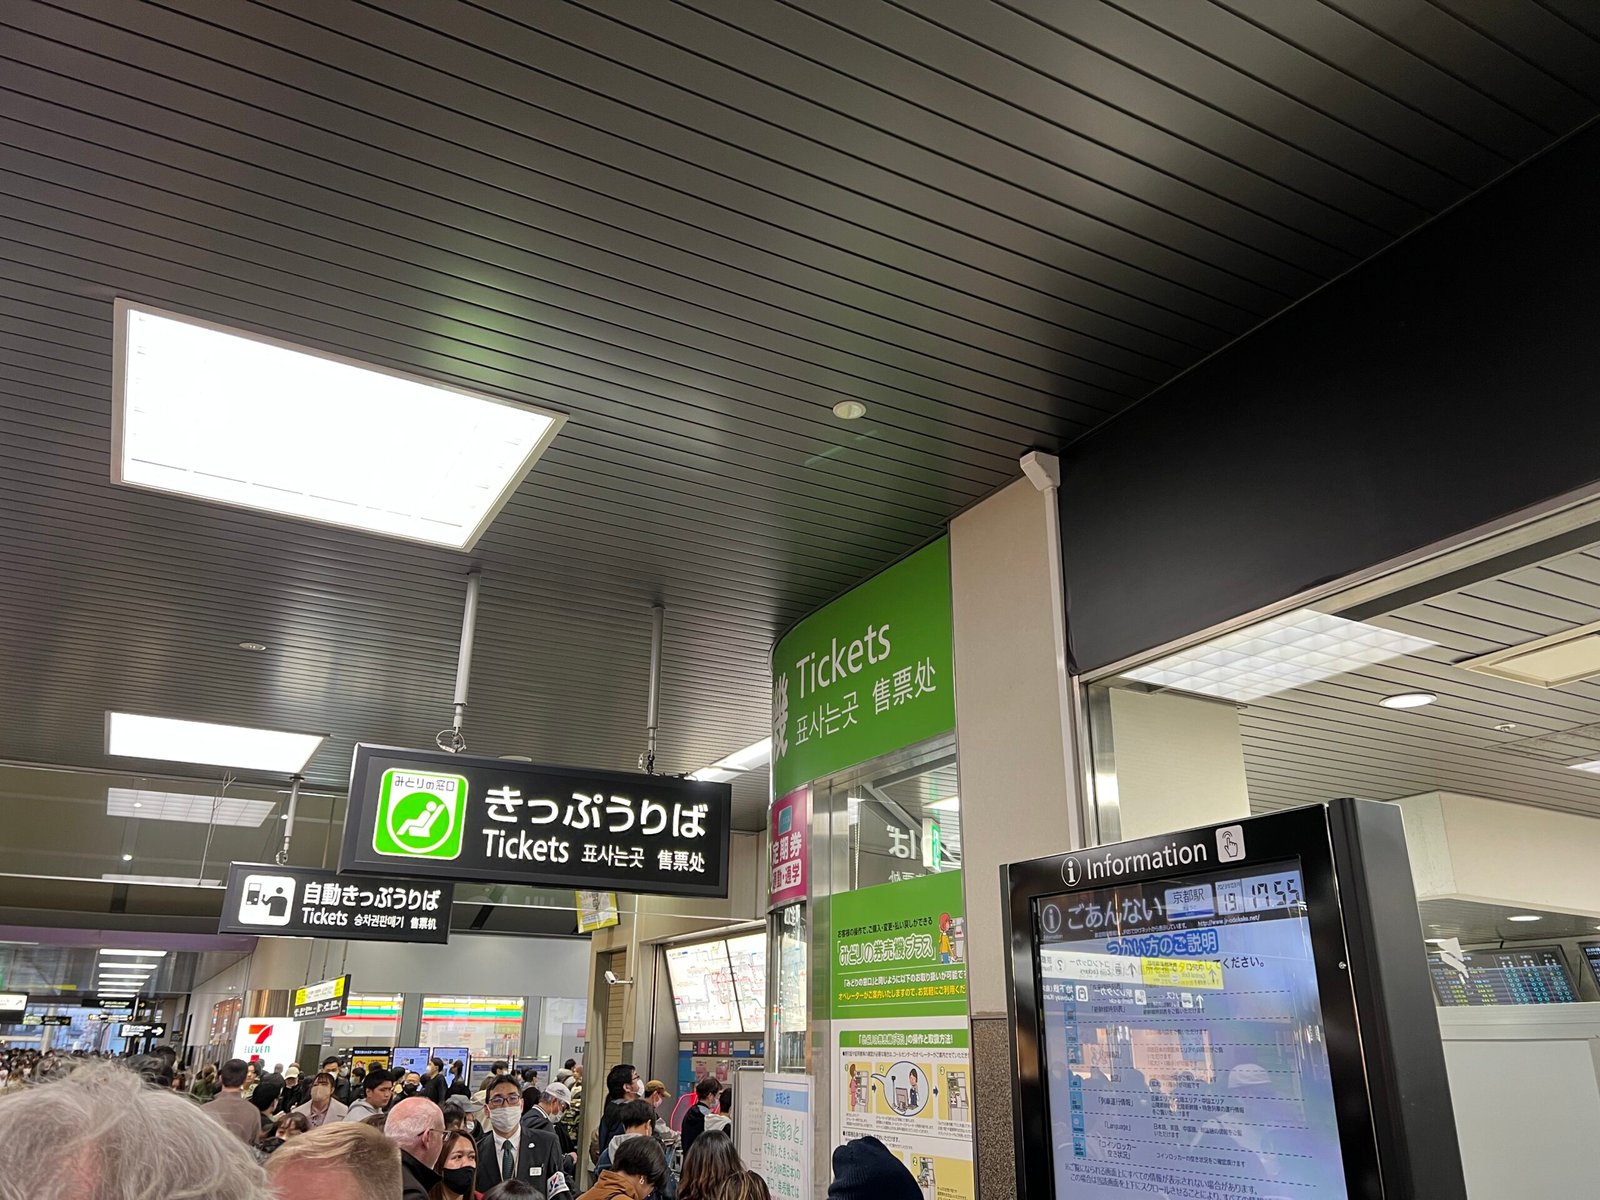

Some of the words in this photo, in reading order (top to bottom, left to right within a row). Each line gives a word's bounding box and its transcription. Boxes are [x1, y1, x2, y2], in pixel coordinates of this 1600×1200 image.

[796, 624, 891, 699] Tickets
[796, 691, 859, 746] 표사는곳
[872, 656, 937, 715] 售票处
[394, 775, 456, 792] みどりの窓口
[485, 786, 711, 839] きっぷうりば
[482, 828, 569, 864] Tickets
[581, 844, 645, 868] 표사는곳
[657, 850, 705, 873] 售票处
[1087, 842, 1208, 881] Information
[303, 881, 441, 911] 自動きっぷうりば
[1067, 896, 1163, 930] ごあんない
[1172, 888, 1206, 904] 京都駅
[302, 907, 348, 926] Tickets
